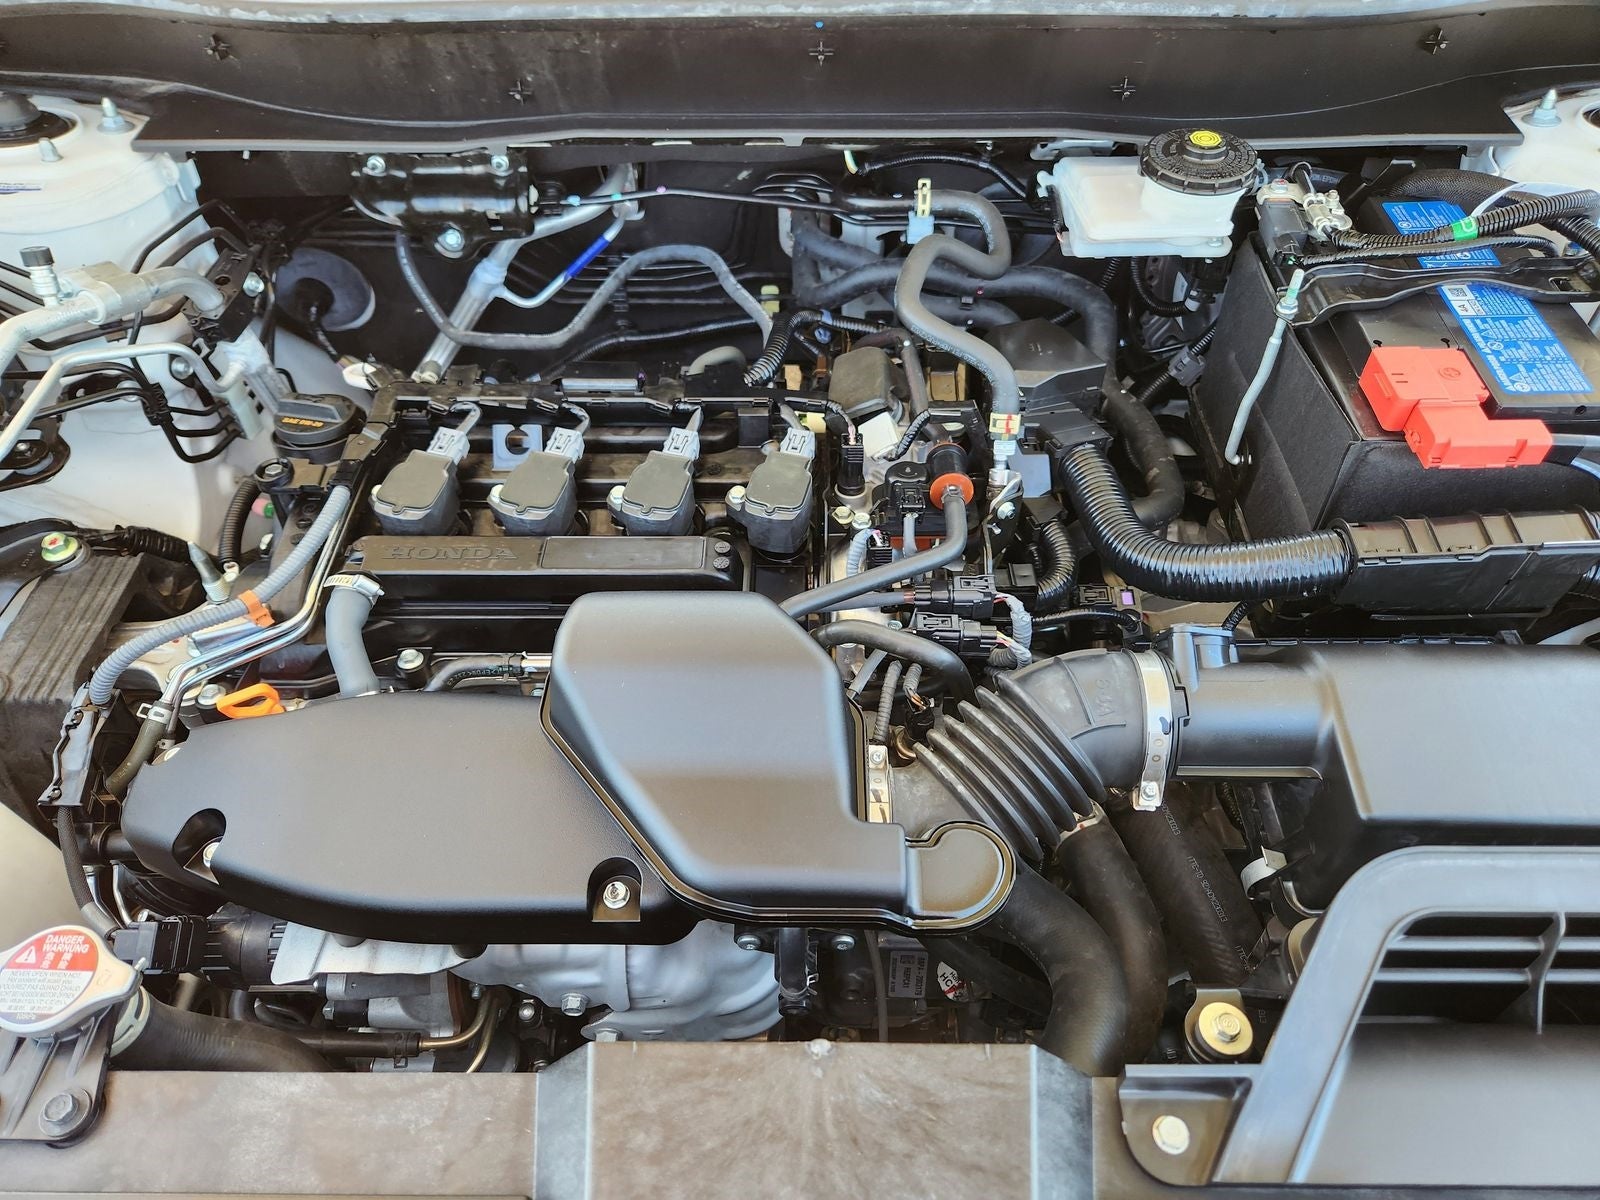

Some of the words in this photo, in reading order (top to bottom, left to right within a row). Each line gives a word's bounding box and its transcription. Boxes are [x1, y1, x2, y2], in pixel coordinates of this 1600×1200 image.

[381, 546, 519, 560] HONDA
[46, 934, 85, 944] DANGER
[42, 943, 90, 954] WARNUNG
